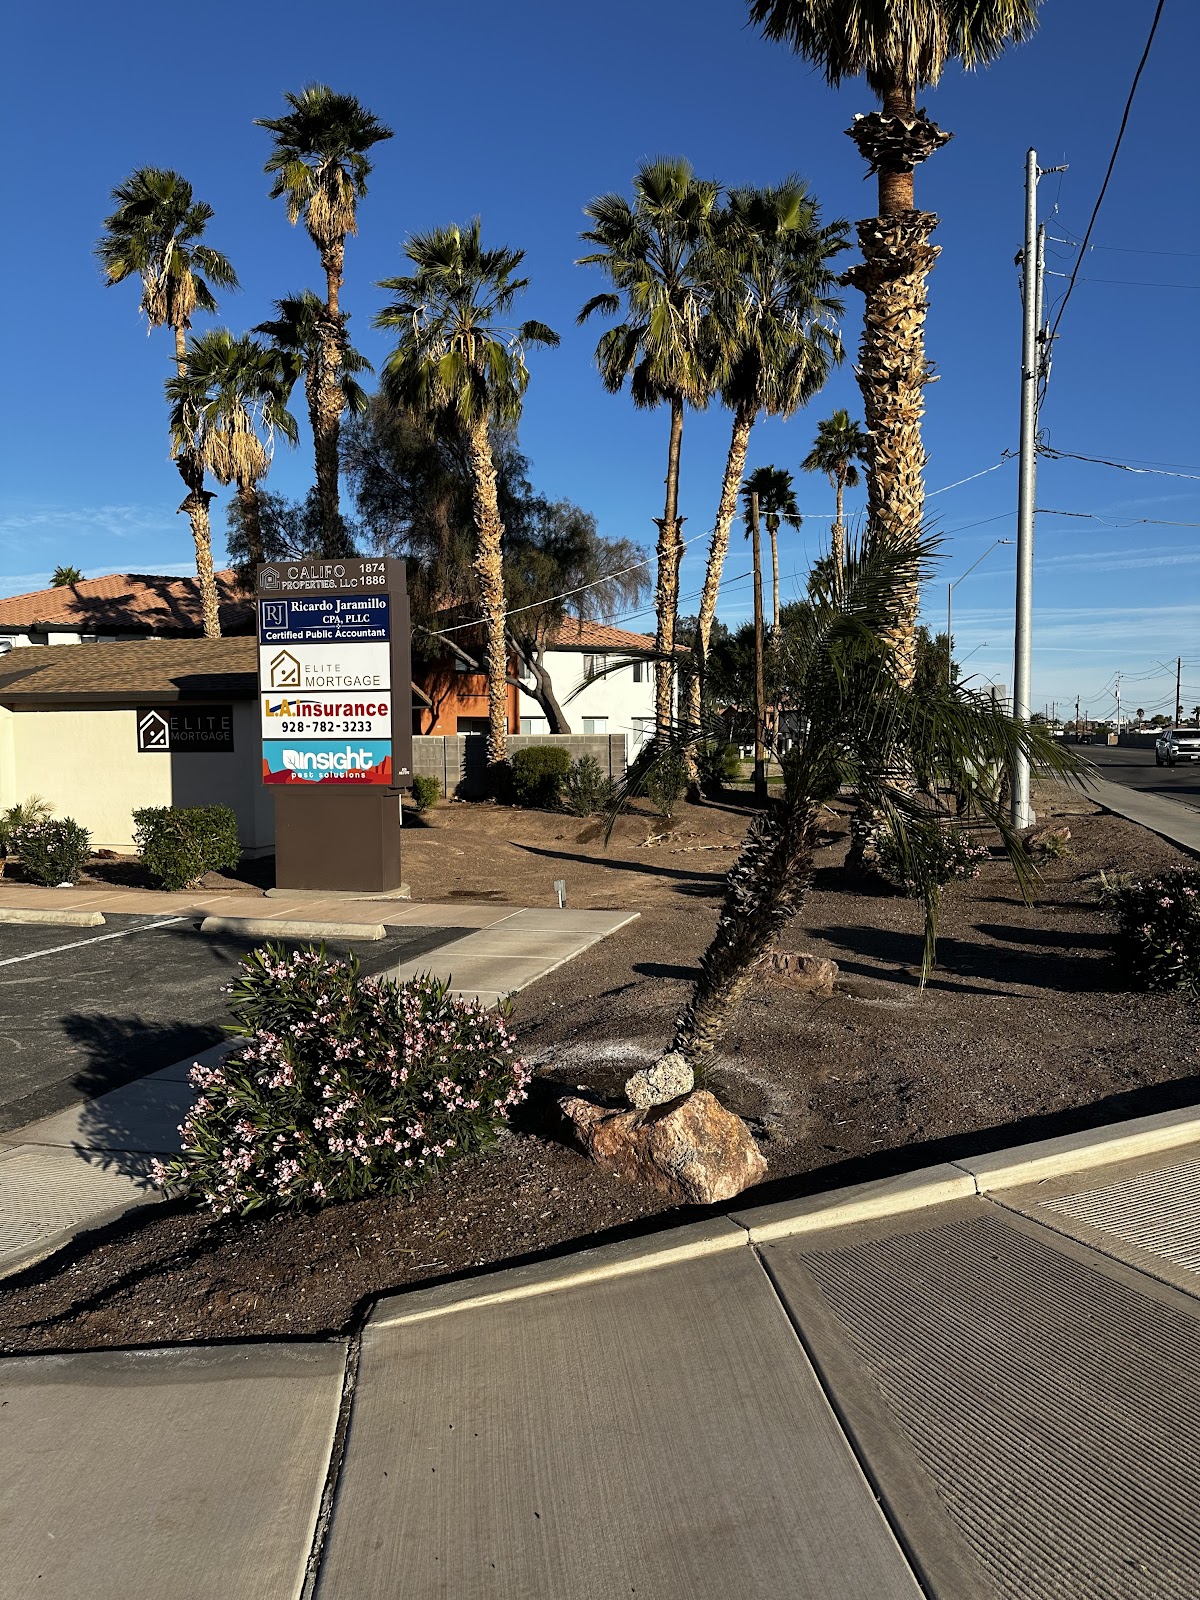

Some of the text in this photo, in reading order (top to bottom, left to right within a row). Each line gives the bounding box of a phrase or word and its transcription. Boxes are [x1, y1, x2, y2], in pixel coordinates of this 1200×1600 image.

[287, 565, 346, 579] CALIFO
[359, 563, 386, 573] 1874
[339, 578, 358, 588] LLC
[359, 575, 386, 586] 1886
[291, 598, 387, 613] Ricardo Jaramillo
[266, 605, 283, 625] RJ
[322, 613, 370, 625] CPA, PLLC
[265, 628, 386, 640] Certified Public Accountant
[304, 664, 341, 673] ELITE
[305, 675, 381, 687] MORTGAGE
[170, 717, 230, 729] ELITE
[281, 721, 372, 733] 928-782-3233
[171, 731, 230, 741] MORTGAGE
[299, 746, 373, 770] insight
[319, 771, 366, 779] solutions
